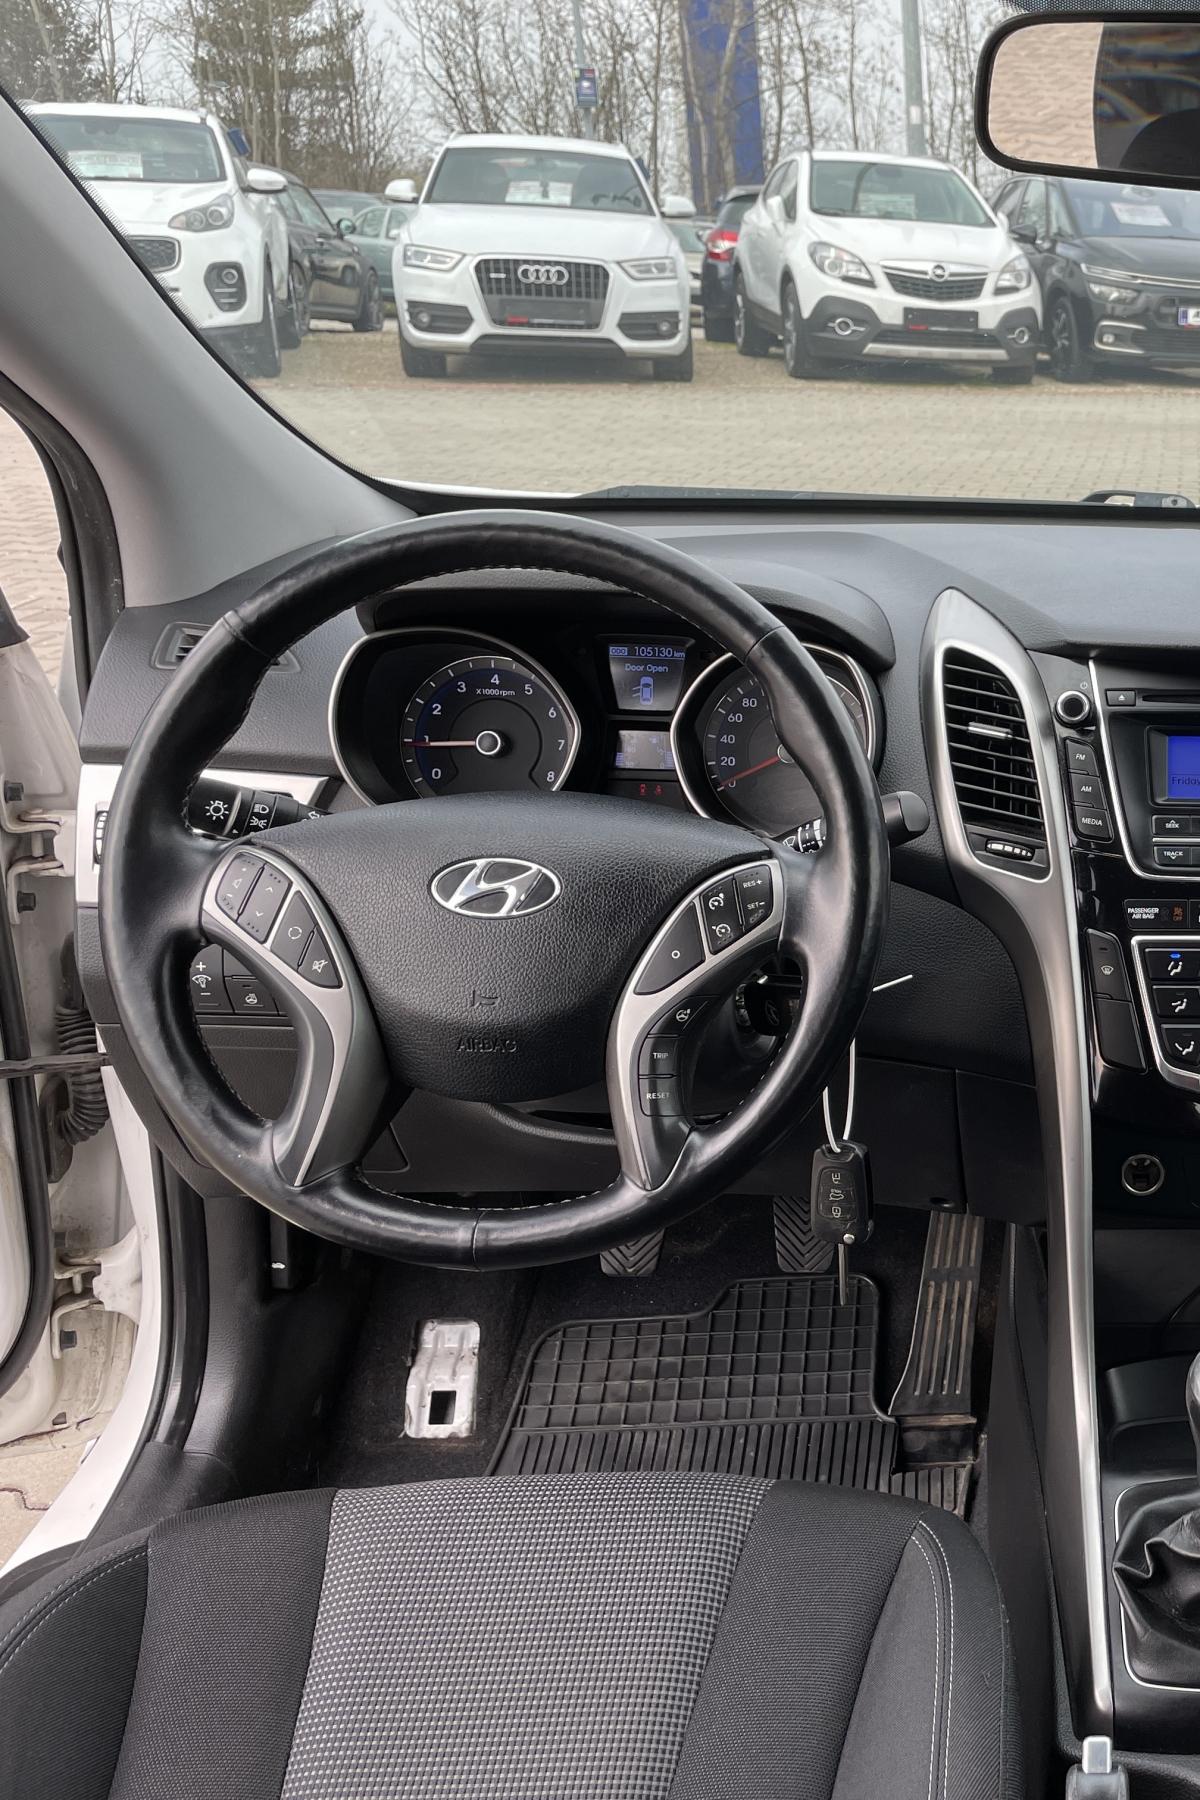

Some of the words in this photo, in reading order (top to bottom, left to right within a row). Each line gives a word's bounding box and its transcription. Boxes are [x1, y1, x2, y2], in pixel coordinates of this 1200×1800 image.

[634, 646, 673, 657] 105130
[674, 650, 686, 658] km
[624, 663, 644, 672] Door
[646, 664, 669, 674] Open
[490, 674, 500, 685] 4
[457, 682, 467, 693] 3
[524, 684, 533, 695] 5
[742, 698, 758, 708] 80
[432, 704, 442, 715] 2
[548, 707, 557, 718] 6
[727, 713, 743, 723] 60
[720, 734, 736, 744] 40
[557, 740, 566, 751] 7
[720, 756, 736, 766] 20
[431, 768, 442, 780] 0
[546, 771, 555, 782] 8
[1080, 785, 1092, 793] AM
[1081, 817, 1103, 826] MEDIA
[456, 1039, 518, 1053] AIRBAG
[653, 1052, 669, 1060] TRIP
[646, 1092, 670, 1100] RESET
